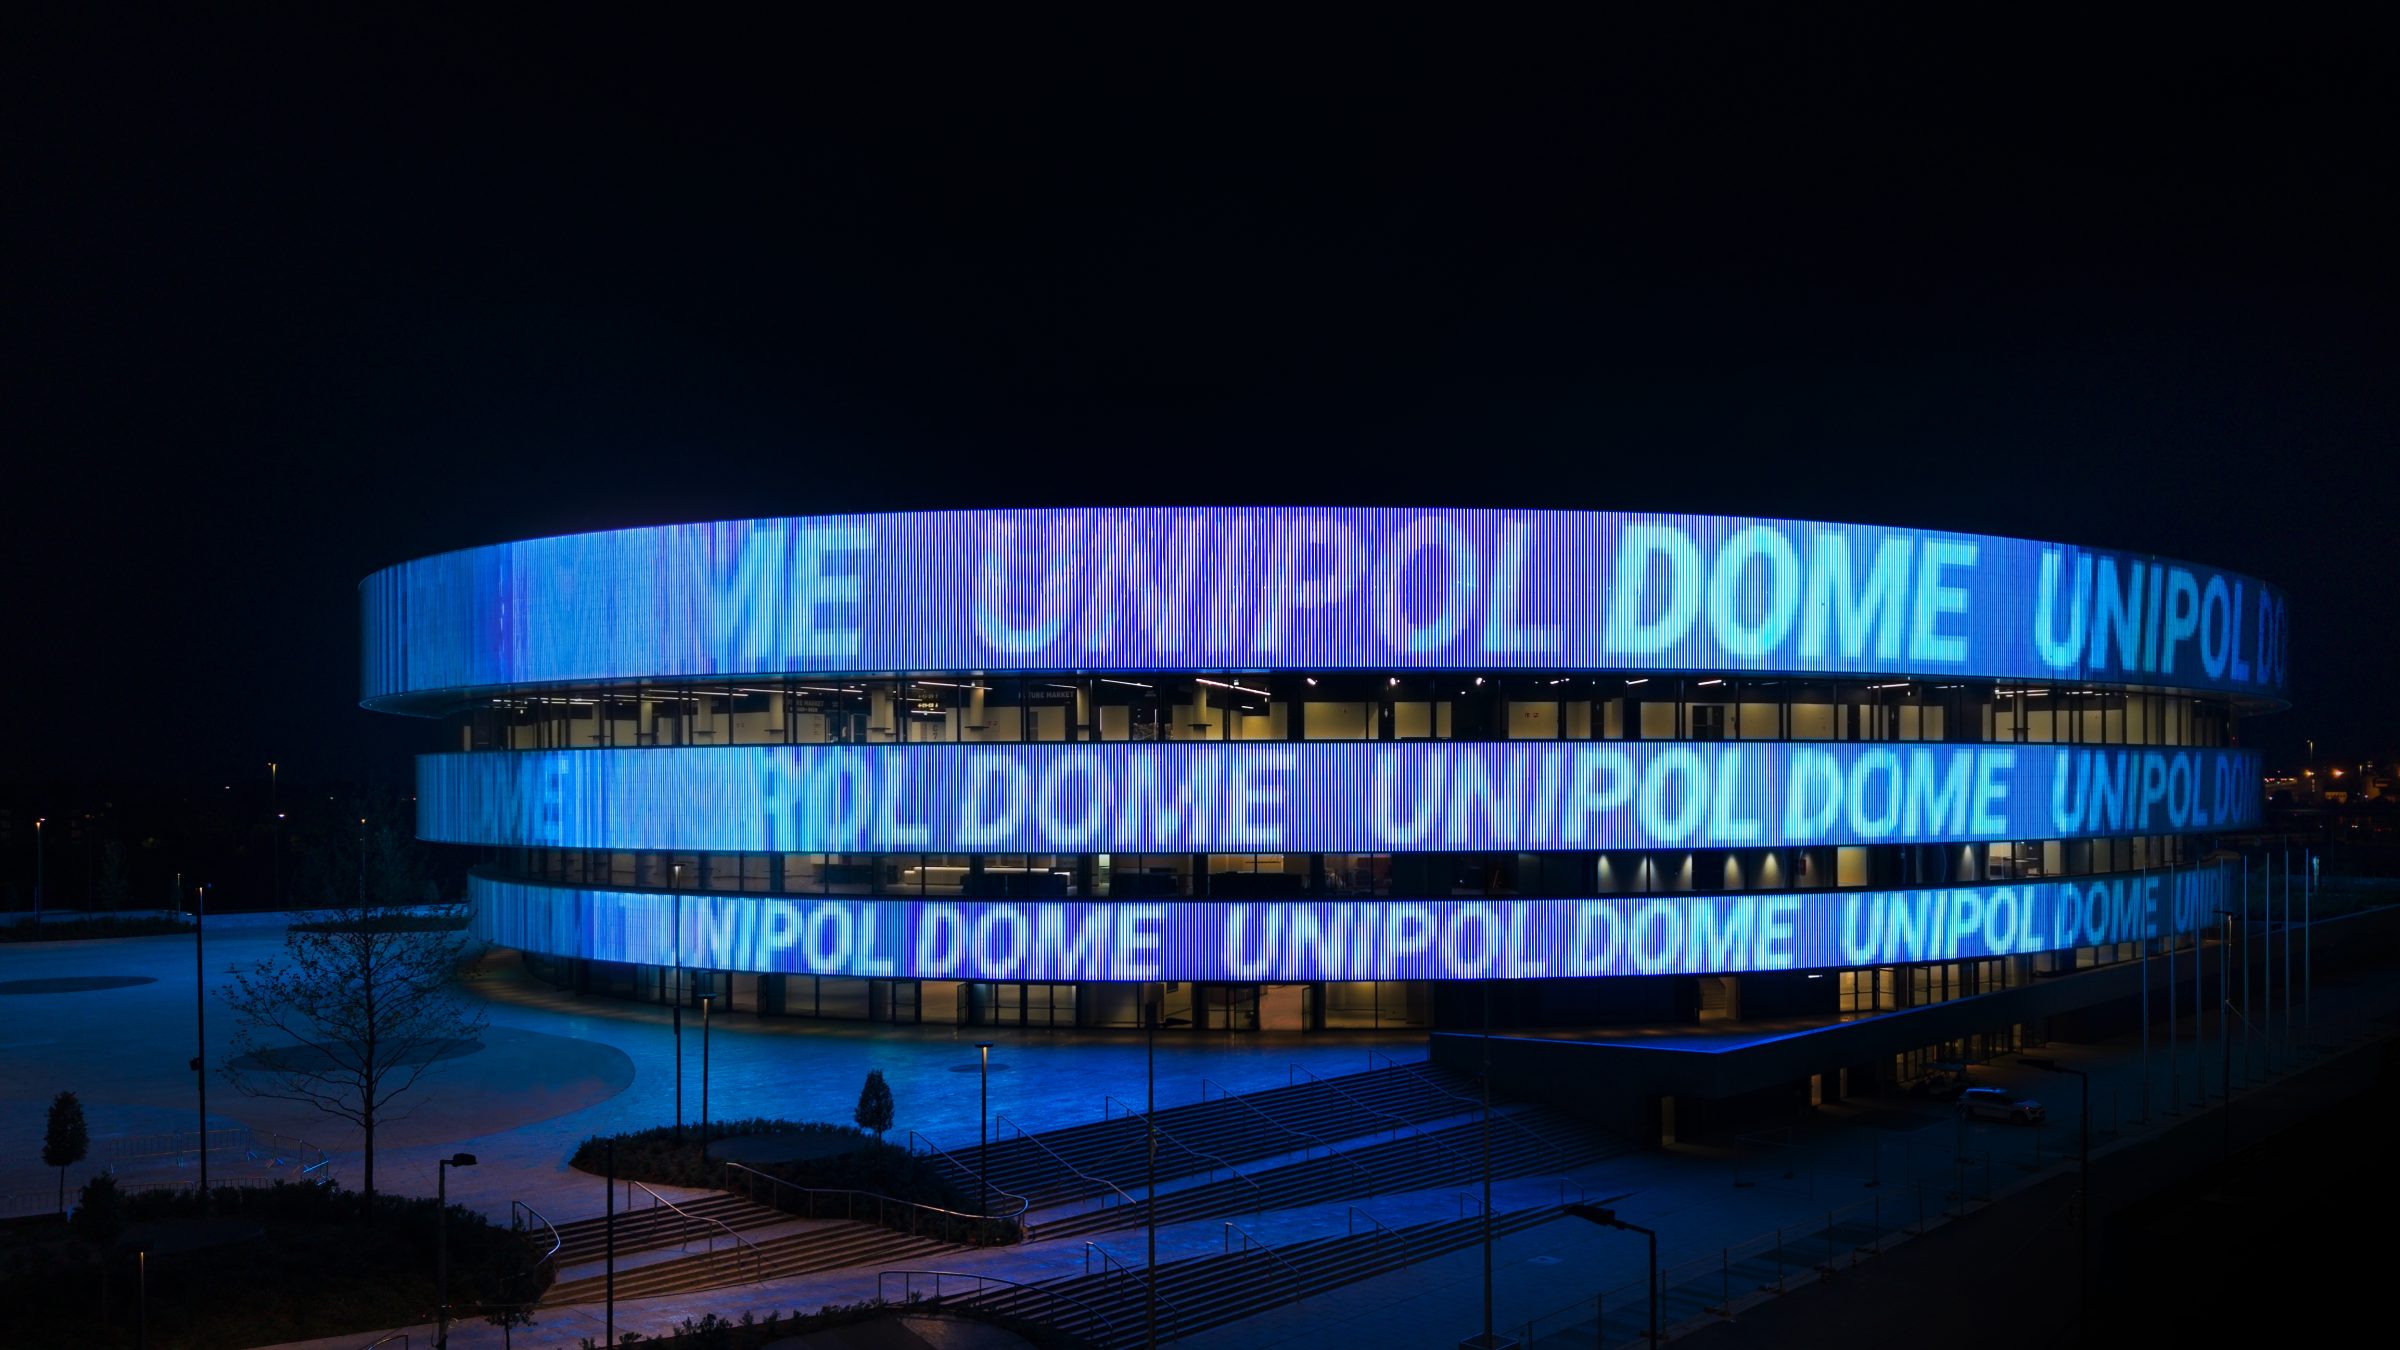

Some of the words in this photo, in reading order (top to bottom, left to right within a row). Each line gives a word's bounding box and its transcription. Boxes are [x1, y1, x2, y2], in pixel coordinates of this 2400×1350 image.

[974, 514, 1563, 654] UNIPOL
[1607, 522, 1979, 663] DOME
[2035, 546, 2249, 681] UNIPOL
[1047, 690, 1075, 698] MARKET
[957, 751, 1296, 846] DOME
[1374, 748, 1760, 846] UNIPOL
[1781, 748, 2016, 841] DOME
[2051, 748, 2209, 832] UNIPOL
[914, 904, 1162, 979] DOME
[1223, 902, 1546, 979] UNIPOL
[1578, 899, 1800, 975] DOME
[1841, 885, 2042, 966] UNIPOL
[2058, 875, 2159, 946] DOME
